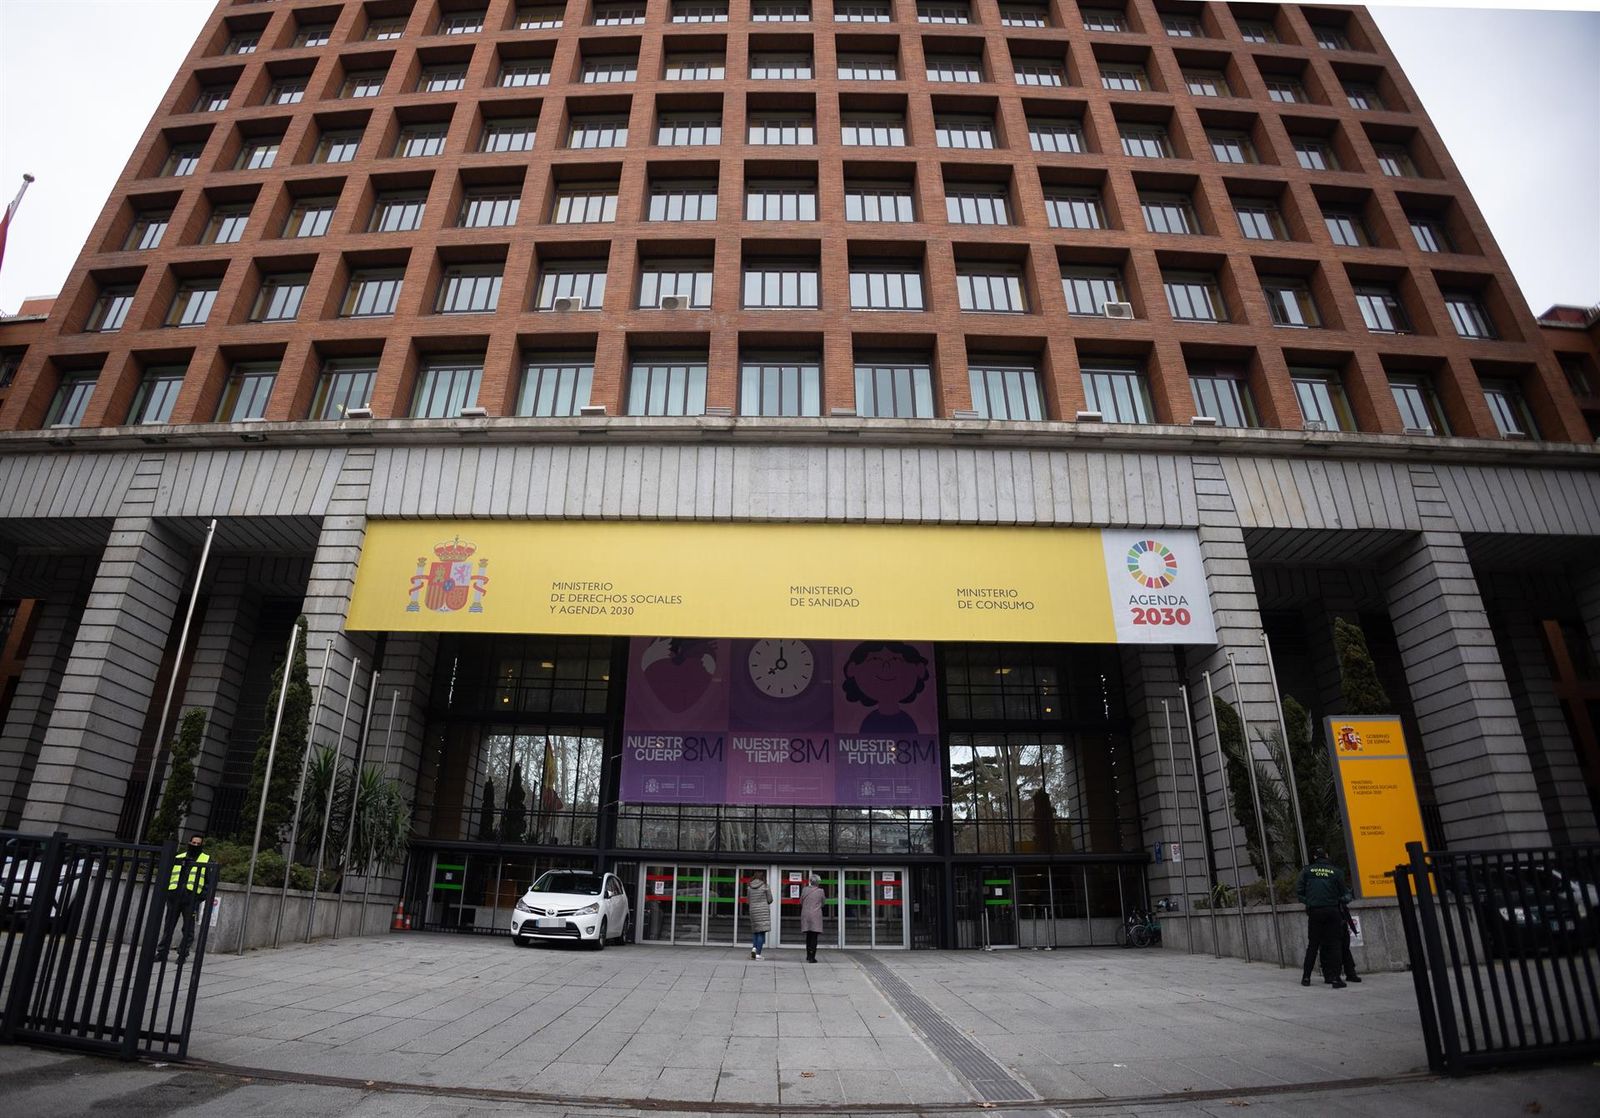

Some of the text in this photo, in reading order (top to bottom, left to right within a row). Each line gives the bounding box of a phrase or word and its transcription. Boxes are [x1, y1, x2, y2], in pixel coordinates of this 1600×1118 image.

[552, 582, 613, 591] MINISTERIO
[790, 586, 853, 595] MINISTERIO
[957, 588, 1018, 598] MINISTERIO
[551, 593, 683, 605] DE DERECHOS SOCIALES
[790, 597, 860, 608] DE SANIDAD
[1129, 595, 1189, 606] AGENDA
[550, 605, 634, 616] Y AGENDA 2030
[958, 600, 1034, 610] DE CONSUMO
[1130, 607, 1192, 626] 2030
